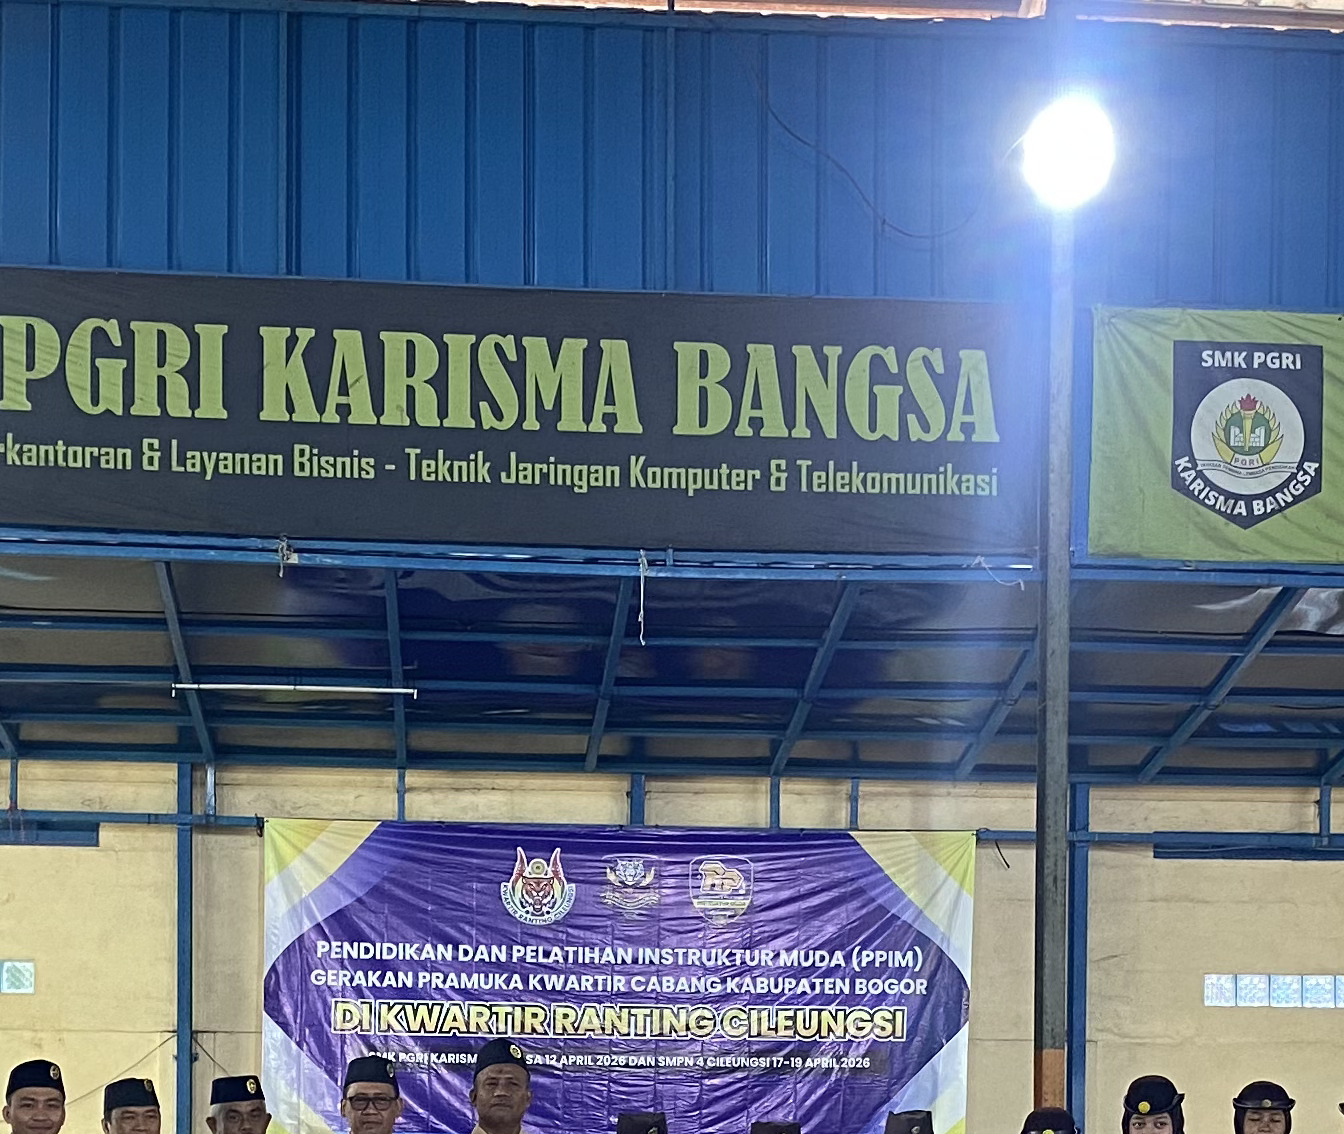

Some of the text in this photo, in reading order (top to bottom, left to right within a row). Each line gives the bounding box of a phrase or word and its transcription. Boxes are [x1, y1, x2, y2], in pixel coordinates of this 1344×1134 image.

[1201, 350, 1302, 370] SMK PGRI
[258, 326, 644, 435] KARISMA
[673, 341, 1000, 443] BANGSA
[142, 441, 160, 472] &
[170, 441, 283, 481] Layanan
[293, 444, 375, 480] Bisnis
[406, 449, 491, 484] Teknik
[501, 452, 620, 494] Jaringan
[629, 455, 760, 497] Komputer
[770, 461, 786, 492] &
[797, 459, 999, 497] Telekomunikasi
[1174, 456, 1320, 516] KARISMA BANGSA
[316, 940, 924, 971] PENDIDIKAN DAN PELATIHAN INSTRUKTUR MUDA (PPIM)
[310, 969, 928, 996] GERAKAN PRAMUKA KWARTIR CABANG KABUPATEN BOGOR
[332, 1000, 907, 1041] DI KWARTIR RANTING CILEUNGSI
[399, 1052, 428, 1063] PGRI
[431, 1053, 478, 1064] KARISM
[545, 1054, 556, 1065] 12
[560, 1055, 594, 1066] APRIL
[596, 1056, 626, 1066] 2026
[629, 1056, 655, 1066] DAN
[658, 1057, 694, 1067] SMPN
[695, 1057, 704, 1067] 4
[706, 1057, 770, 1068] CILEUNGSI
[772, 1057, 802, 1068] 17-19
[805, 1058, 839, 1068] APRIL
[841, 1057, 870, 1068] 2026
